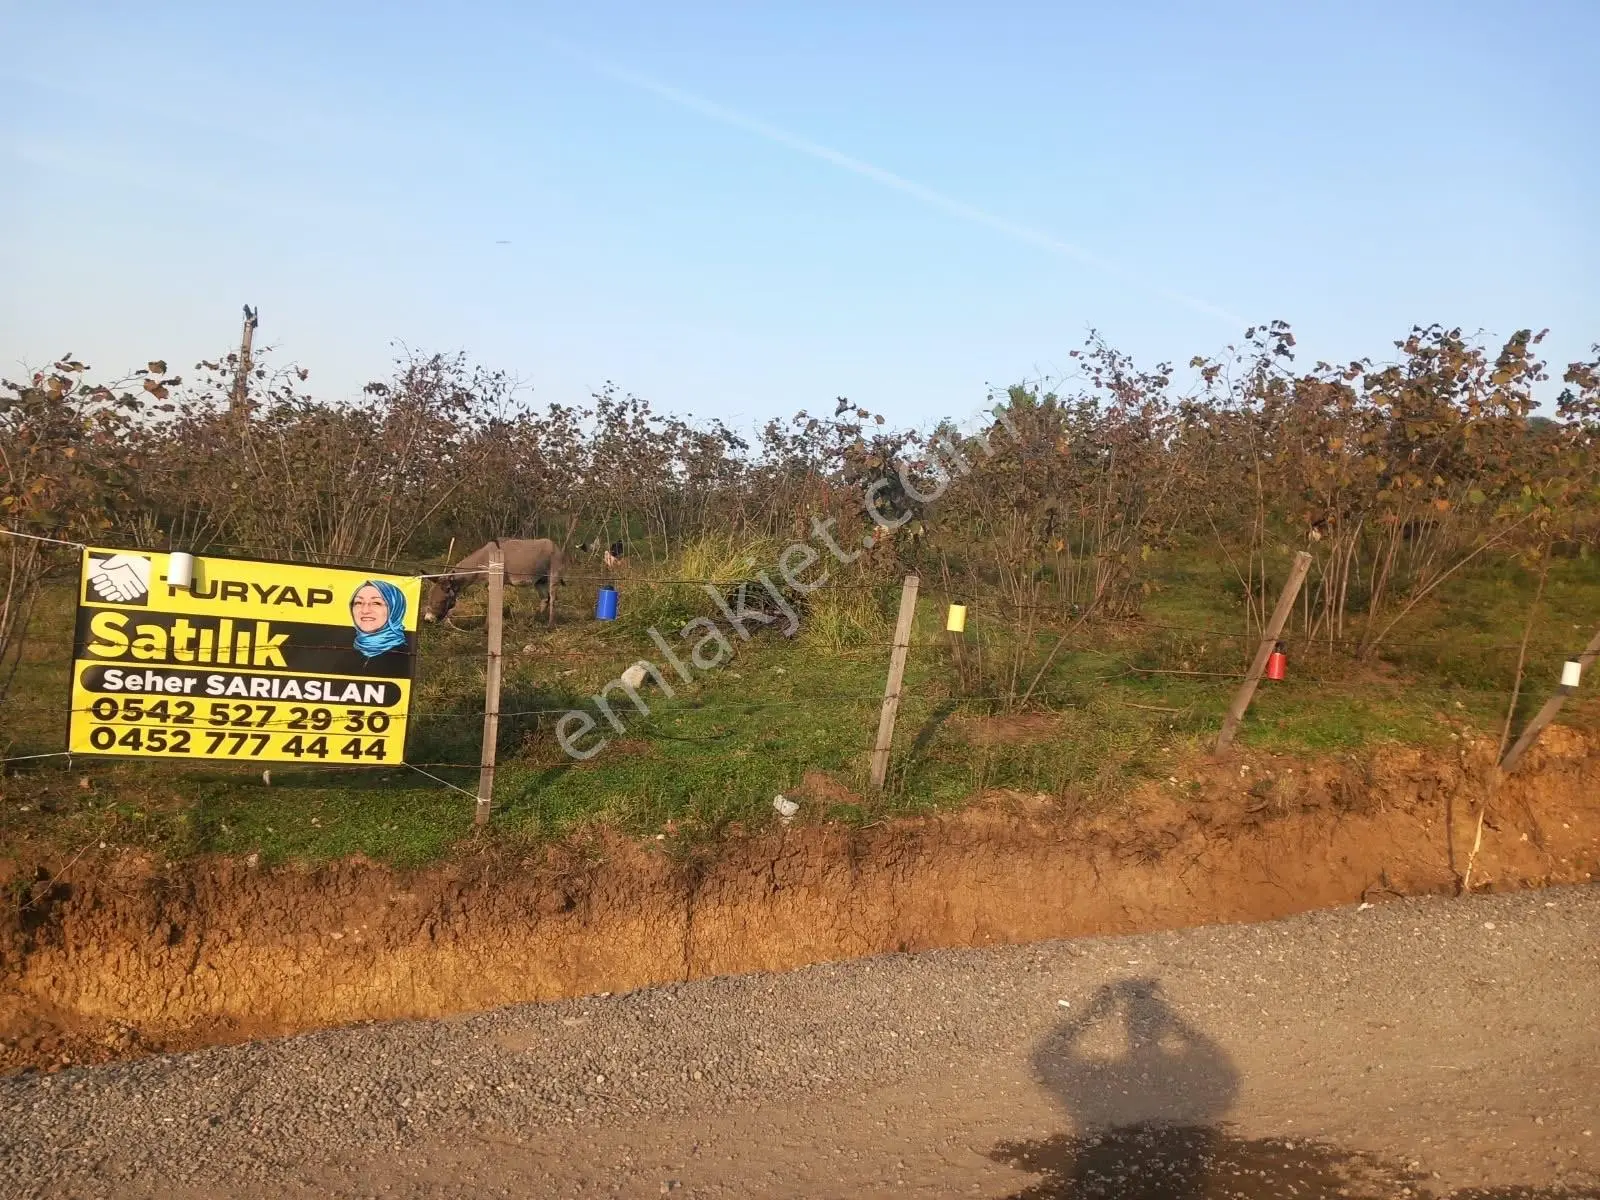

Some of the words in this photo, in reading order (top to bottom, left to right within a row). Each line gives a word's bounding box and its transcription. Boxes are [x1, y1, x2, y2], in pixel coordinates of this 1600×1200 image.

[87, 611, 290, 667] Satılık
[102, 669, 197, 694] Seher
[205, 675, 385, 705] SARIASLAN
[91, 697, 195, 725] 0542
[209, 703, 276, 728] 527
[289, 707, 331, 731] 29
[344, 710, 390, 734] 30
[89, 726, 191, 754] 0452
[205, 731, 271, 757] 777
[282, 735, 328, 760] 44
[341, 738, 387, 761] 44
